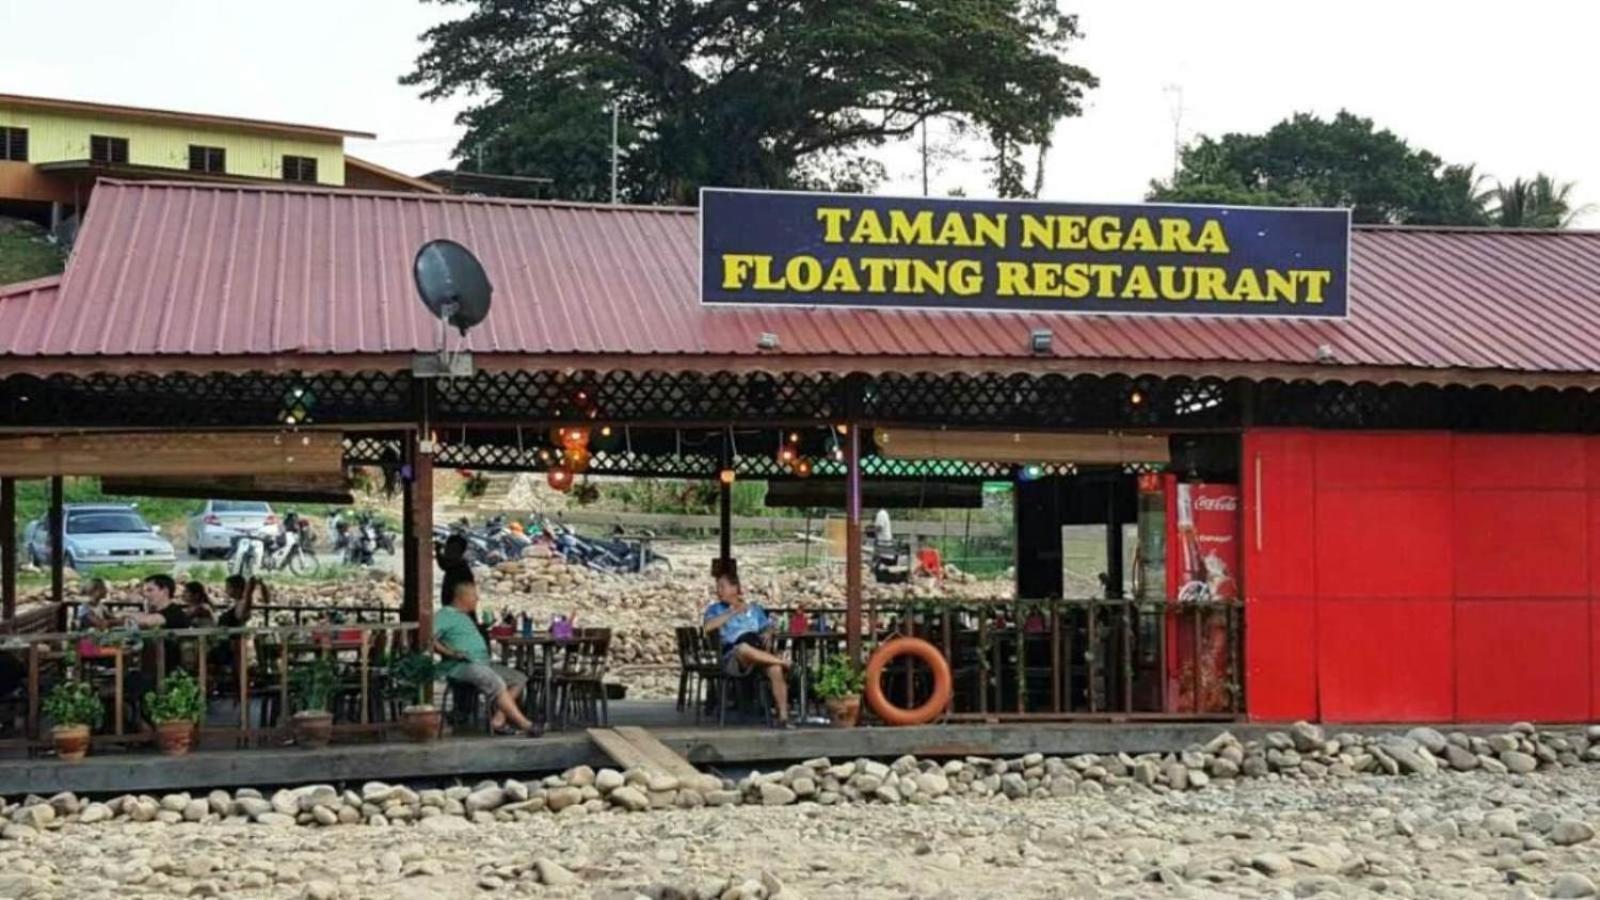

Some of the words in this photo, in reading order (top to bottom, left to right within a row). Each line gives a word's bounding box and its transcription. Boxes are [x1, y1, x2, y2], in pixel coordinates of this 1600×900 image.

[816, 207, 1007, 248] TAMAN
[1021, 214, 1229, 254] NEGARA
[723, 253, 983, 297] FLOATING
[997, 261, 1330, 304] RESTAURANT
